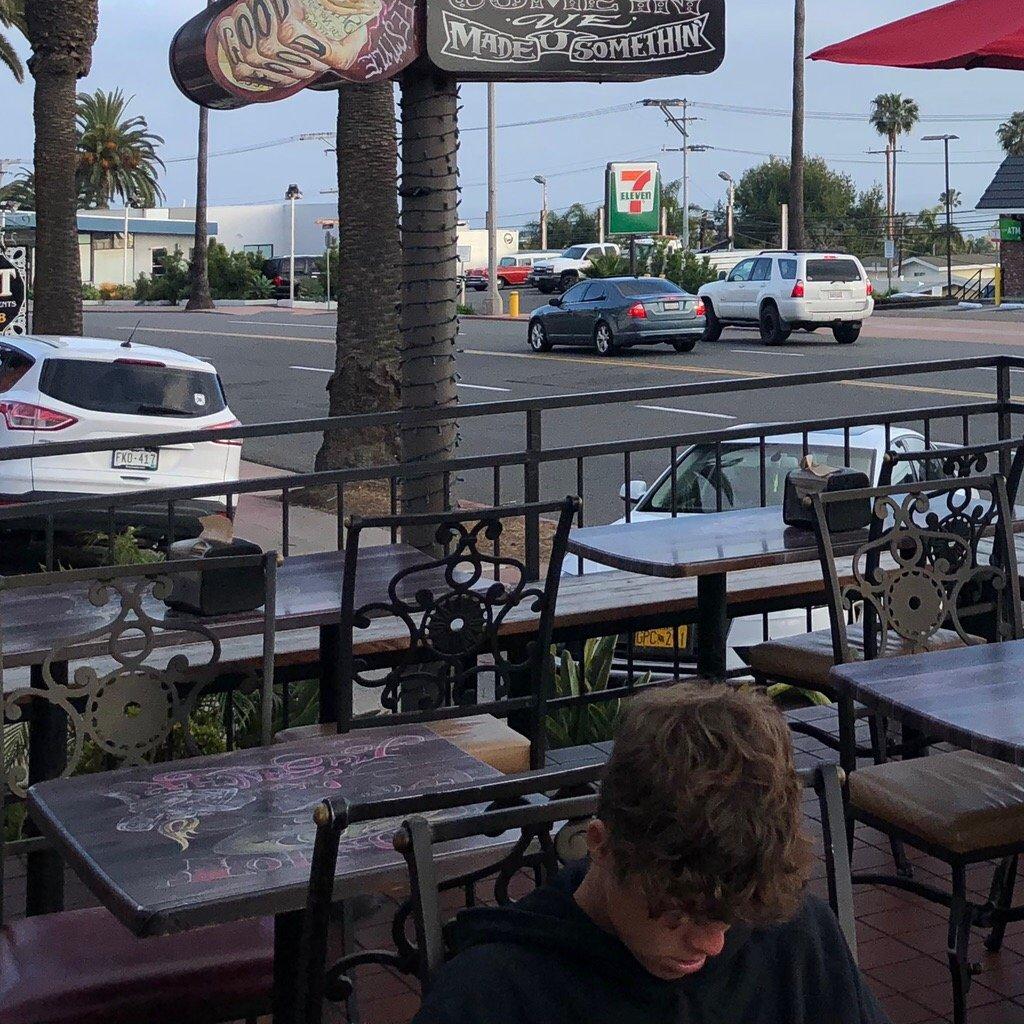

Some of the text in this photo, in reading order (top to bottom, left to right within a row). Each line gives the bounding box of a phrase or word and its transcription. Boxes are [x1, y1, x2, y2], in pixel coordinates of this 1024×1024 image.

[450, 19, 703, 61] MADE U SOMETHIN'
[621, 169, 651, 213] 7
